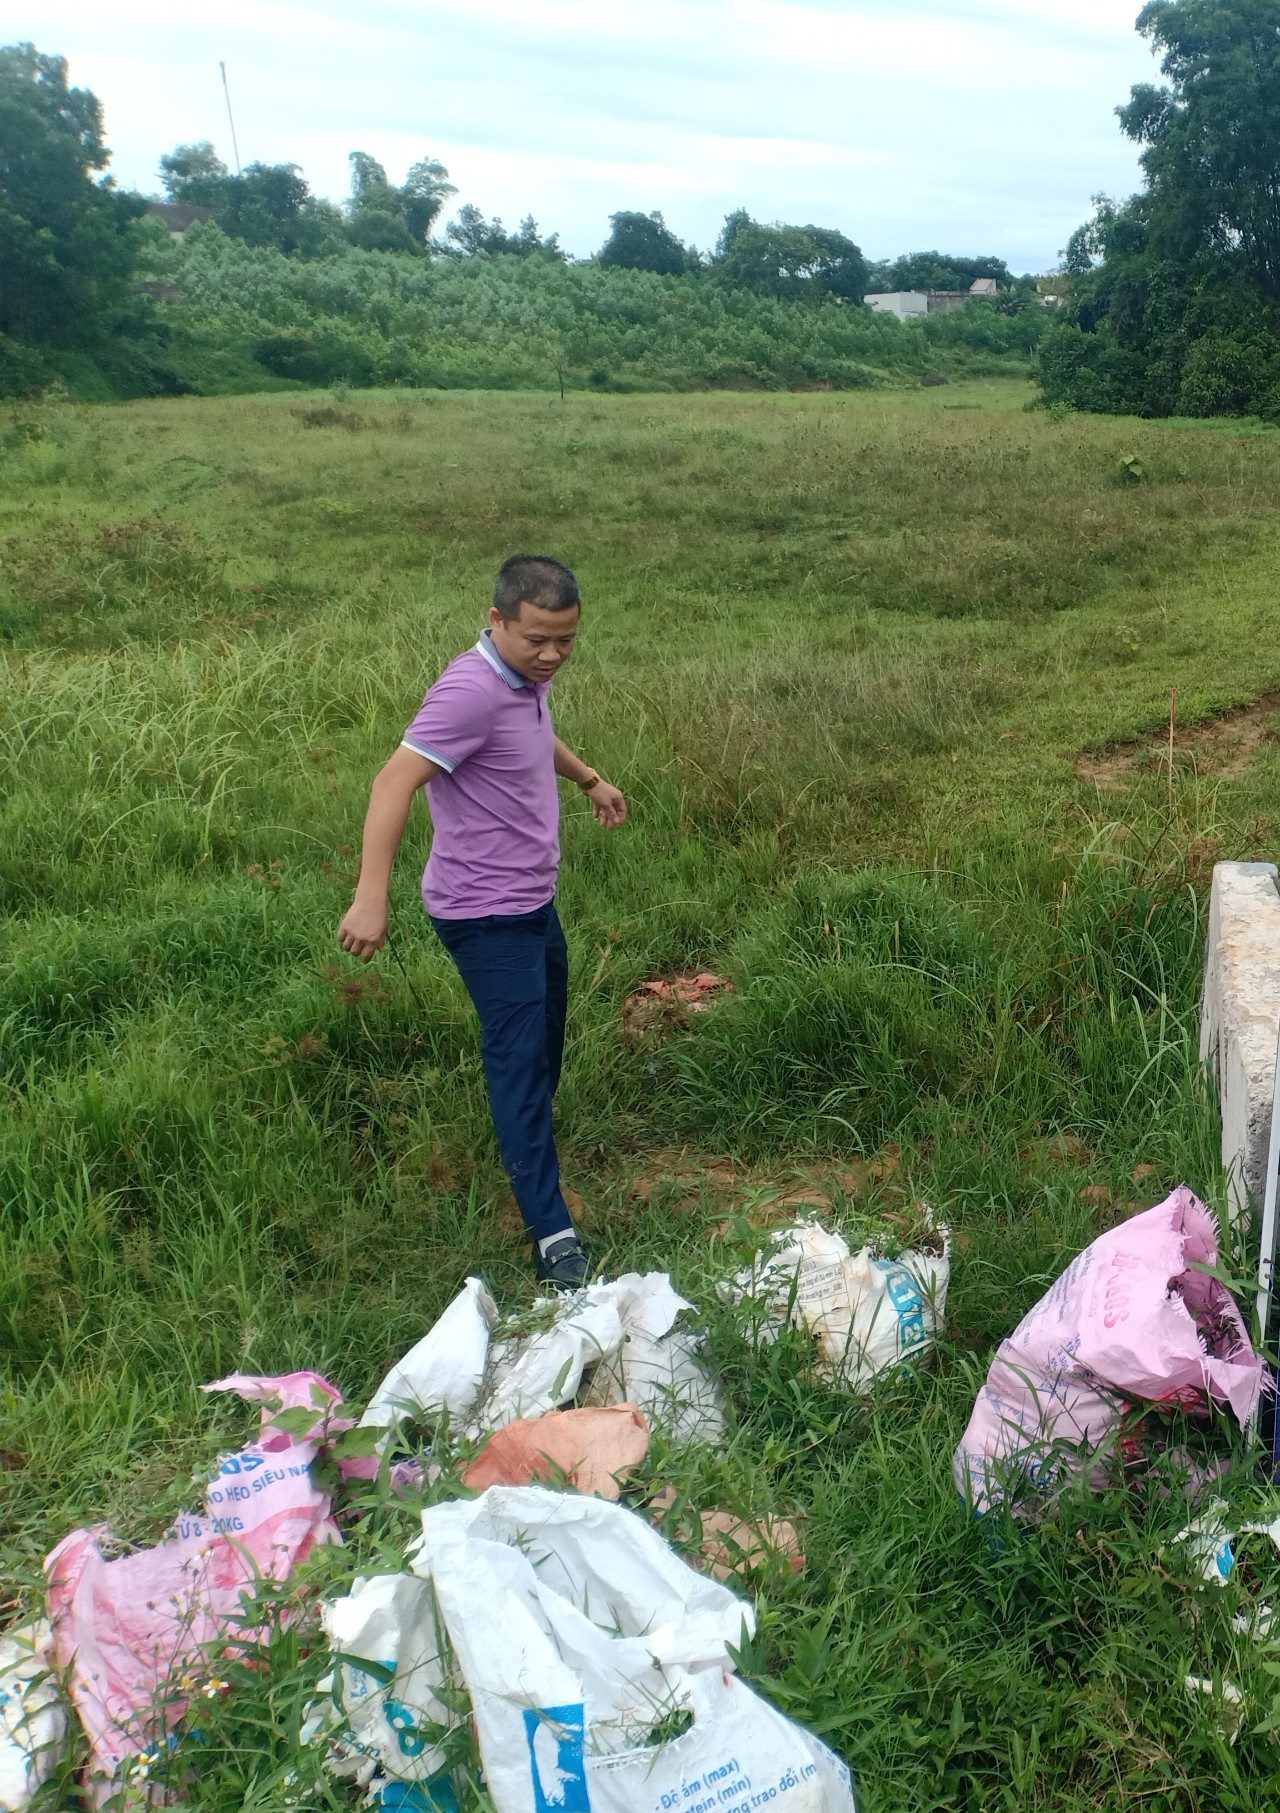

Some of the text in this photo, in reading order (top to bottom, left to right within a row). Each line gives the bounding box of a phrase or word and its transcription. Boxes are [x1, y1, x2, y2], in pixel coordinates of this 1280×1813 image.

[225, 1486, 250, 1502] HEO
[252, 1469, 286, 1492] SIÊU
[193, 1523, 203, 1537] 8
[211, 1516, 245, 1534] 20KG
[702, 1757, 740, 1789] (max)
[751, 1787, 777, 1806] trao
[779, 1767, 800, 1793] đổi
[717, 1774, 751, 1806] (min)
